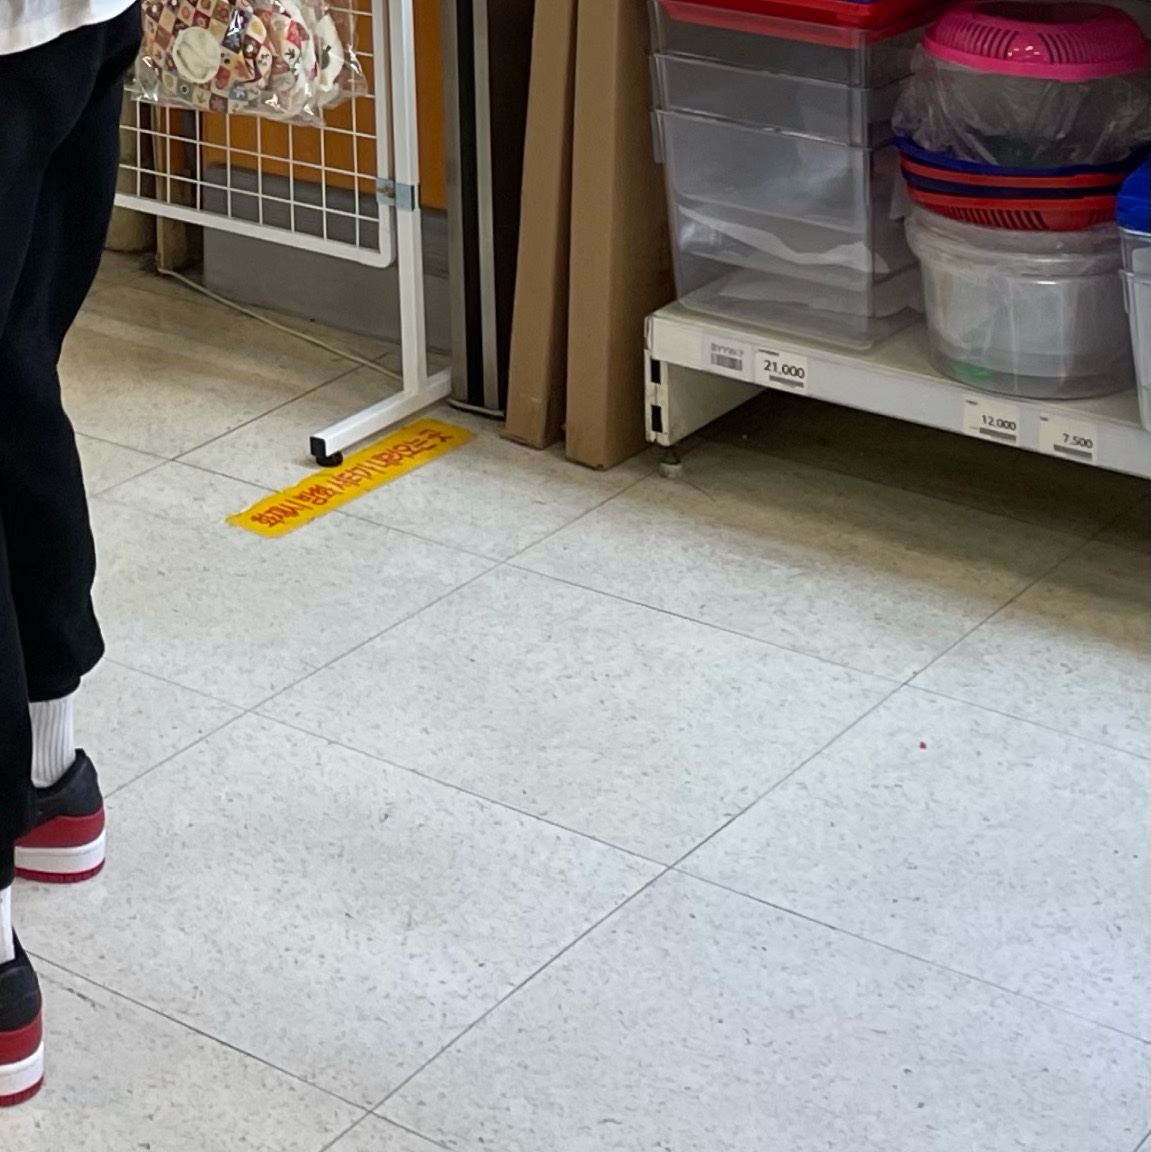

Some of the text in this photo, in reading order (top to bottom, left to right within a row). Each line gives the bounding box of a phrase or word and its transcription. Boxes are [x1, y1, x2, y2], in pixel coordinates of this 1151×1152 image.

[764, 359, 805, 379] 21,000
[981, 414, 1016, 431] 12,000
[1062, 432, 1093, 449] 7,500
